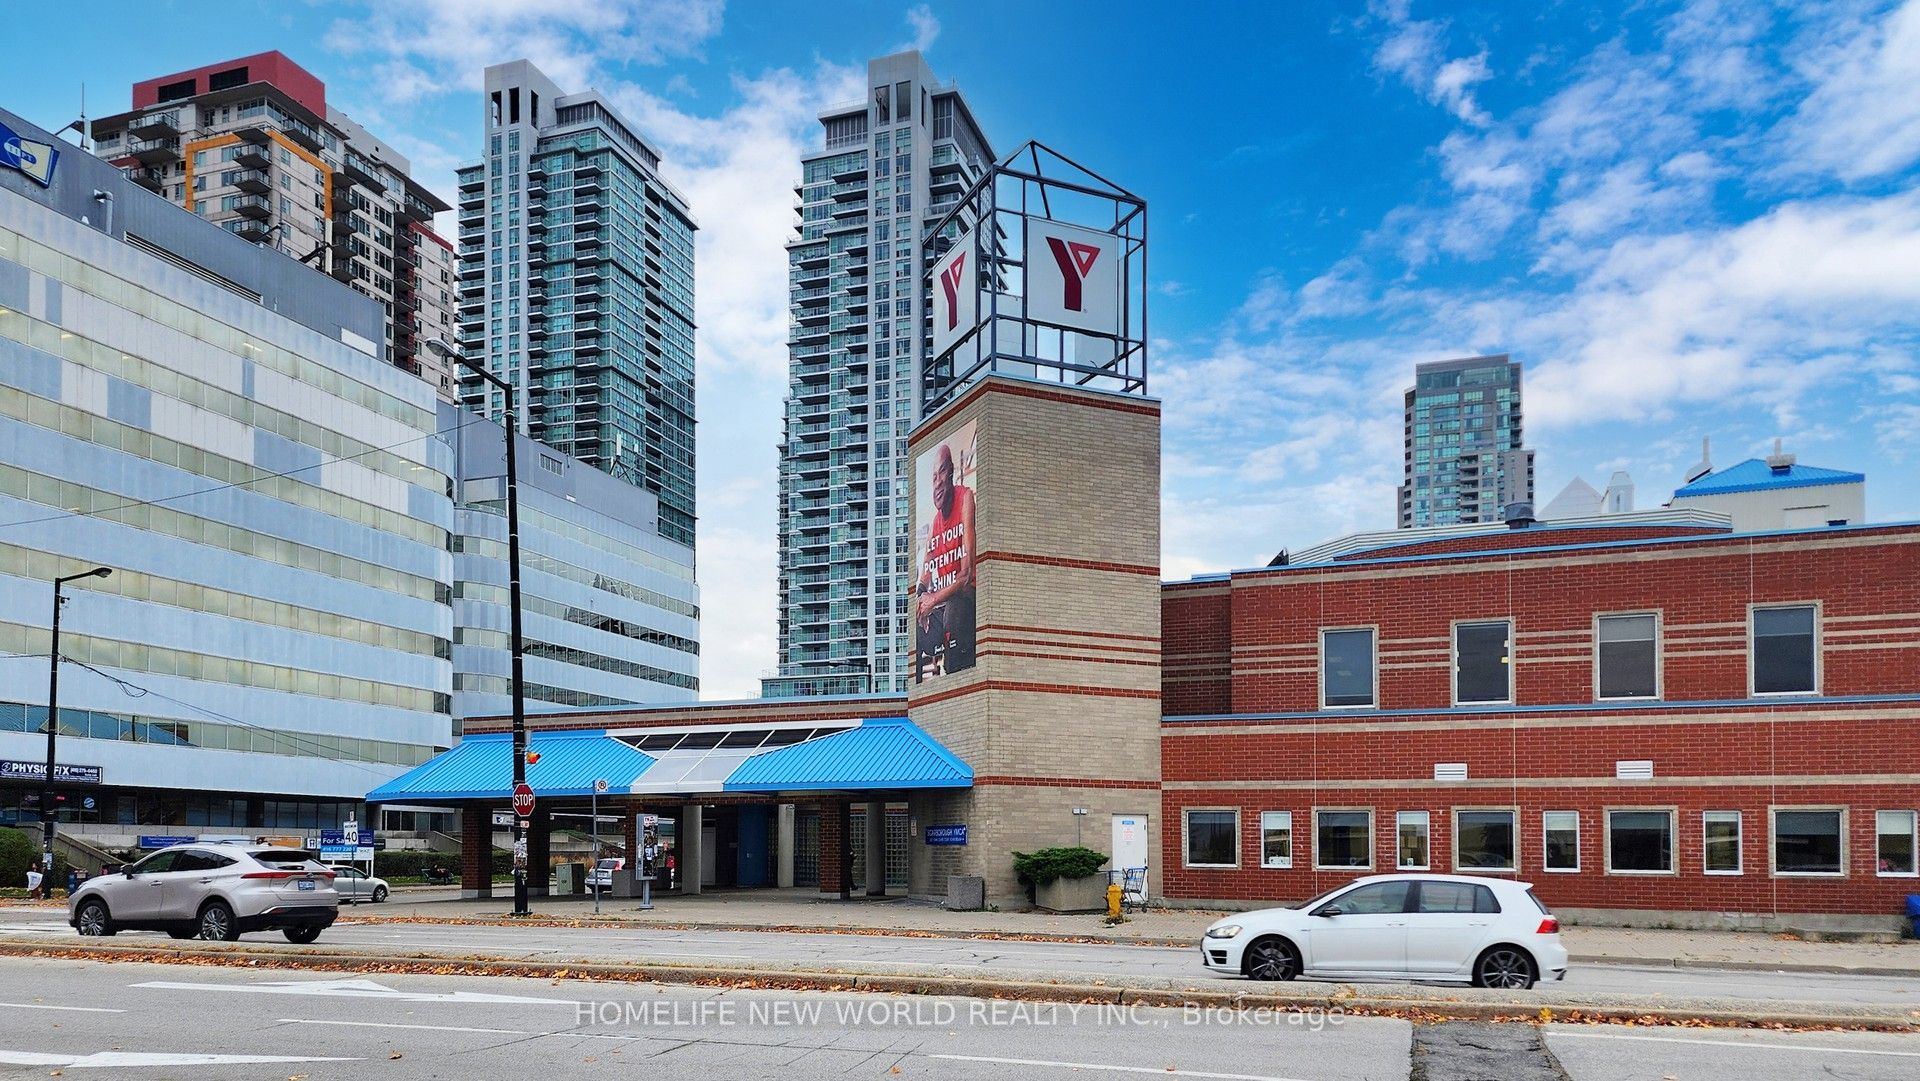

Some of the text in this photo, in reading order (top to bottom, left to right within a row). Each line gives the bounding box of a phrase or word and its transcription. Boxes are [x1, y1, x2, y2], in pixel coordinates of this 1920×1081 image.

[927, 523, 964, 553] LET YOUR
[924, 544, 967, 575] POTENTIAL
[933, 570, 957, 592] SHINE
[514, 793, 534, 806] STOP
[345, 831, 357, 843] 40
